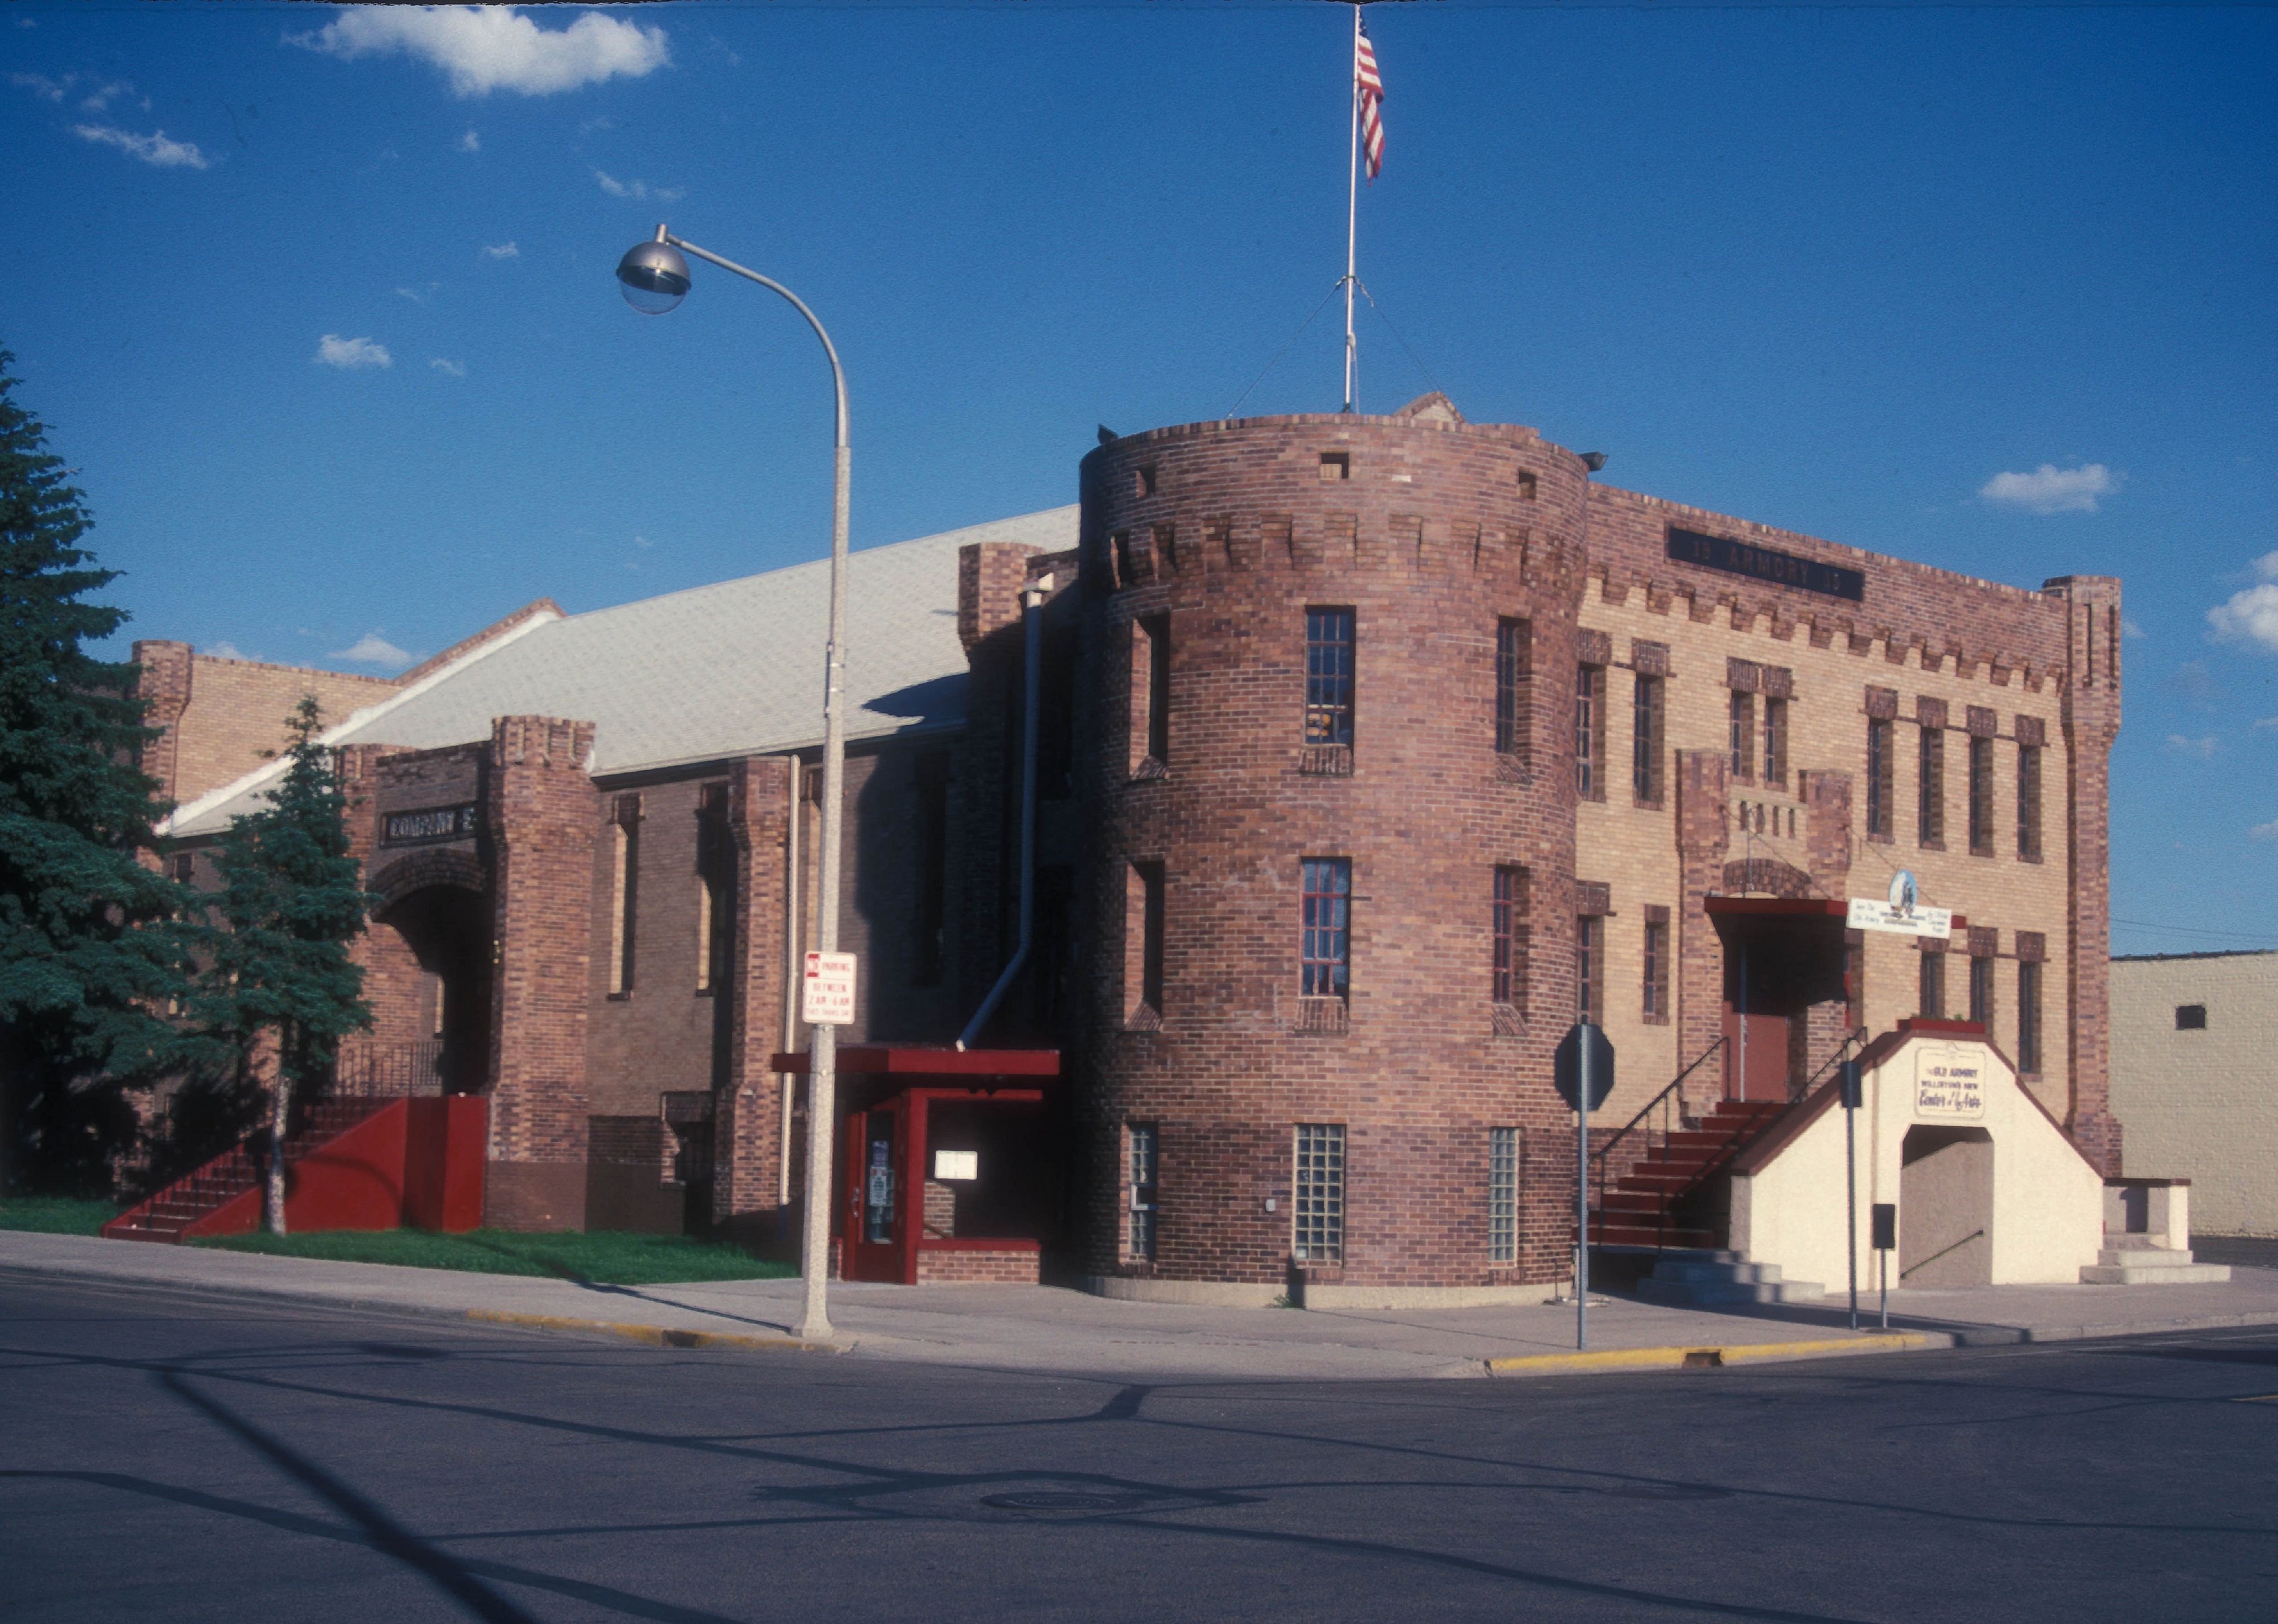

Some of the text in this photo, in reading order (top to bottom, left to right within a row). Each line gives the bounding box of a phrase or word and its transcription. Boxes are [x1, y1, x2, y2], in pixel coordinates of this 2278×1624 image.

[1729, 545, 1810, 585] ARMORY
[390, 807, 475, 838] COMPANY E
[822, 962, 851, 972] PARKING
[813, 982, 846, 993] BETWEEN
[840, 997, 850, 1006] AM
[1934, 1067, 1947, 1077] OLD
[1949, 1067, 1978, 1078] ARMORY
